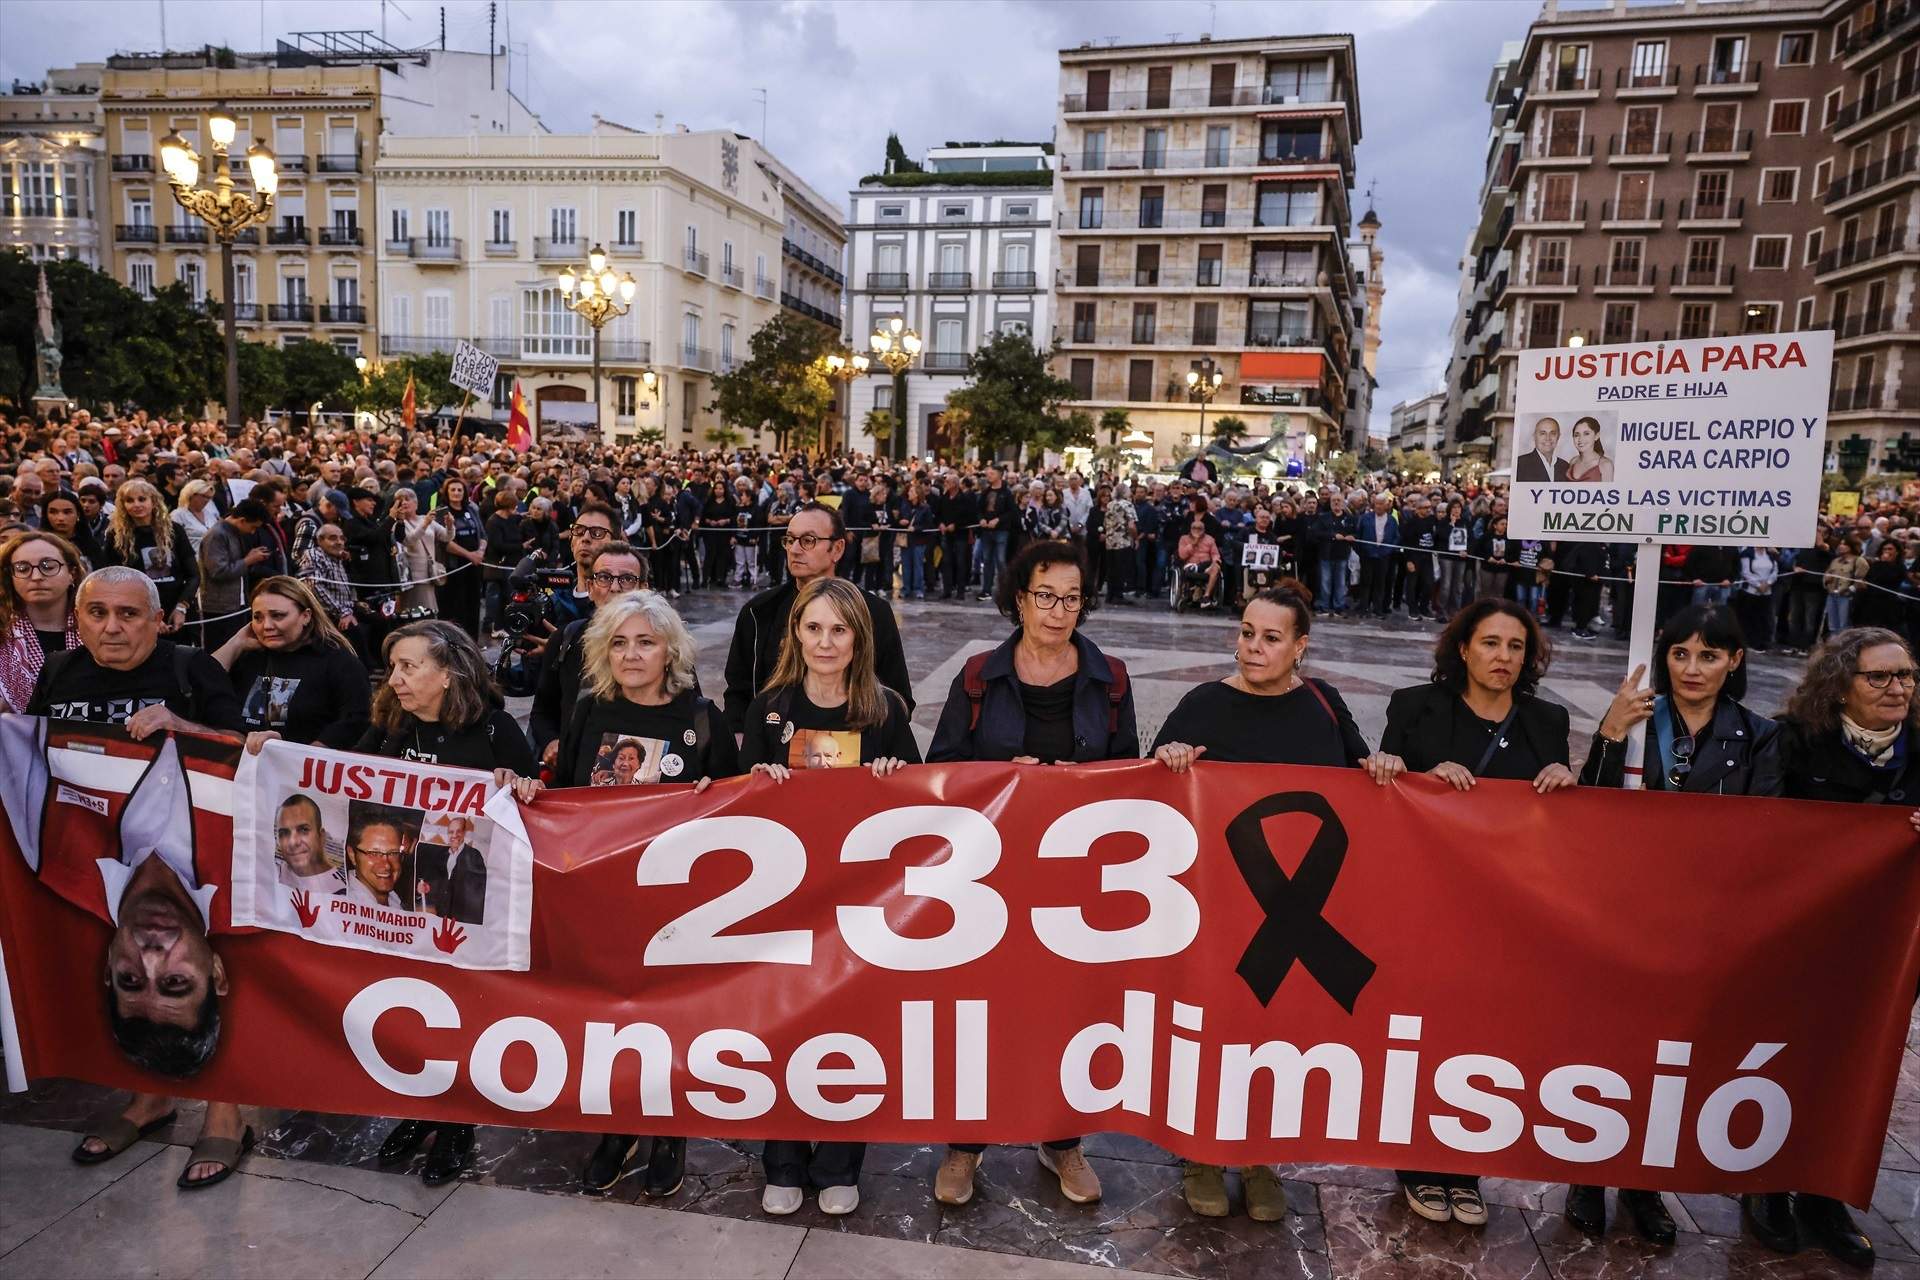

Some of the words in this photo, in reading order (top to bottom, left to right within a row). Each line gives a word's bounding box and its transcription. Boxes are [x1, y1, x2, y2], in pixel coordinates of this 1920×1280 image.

[456, 353, 494, 379] CABRON
[460, 342, 498, 371] MAZON
[1701, 342, 1808, 373] PARA
[455, 363, 489, 386] DERECHO
[1597, 384, 1660, 400] PADRE
[1666, 383, 1678, 397] E
[1683, 381, 1728, 397] HIJA
[1621, 420, 1701, 442] MIGUEL
[1707, 418, 1795, 441] CARPIO
[1802, 417, 1819, 439] Y
[1638, 449, 1698, 470] SARA
[1703, 447, 1791, 470] CARPIO
[1530, 489, 1544, 505] Y
[1548, 488, 1621, 506] TODAS
[1627, 489, 1671, 507] LAS
[1677, 489, 1792, 508] VICTIMAS
[1543, 508, 1634, 532] MAZÓN
[1657, 510, 1770, 536] PRISIÓN
[298, 757, 487, 817] JUSTICIA
[635, 799, 1200, 972] 233
[330, 899, 357, 916] POR
[360, 905, 374, 919] MI
[376, 910, 426, 929] MARIDO
[342, 920, 351, 933] Y
[343, 977, 987, 1121] Consell
[1060, 989, 1792, 1173] dimissió
